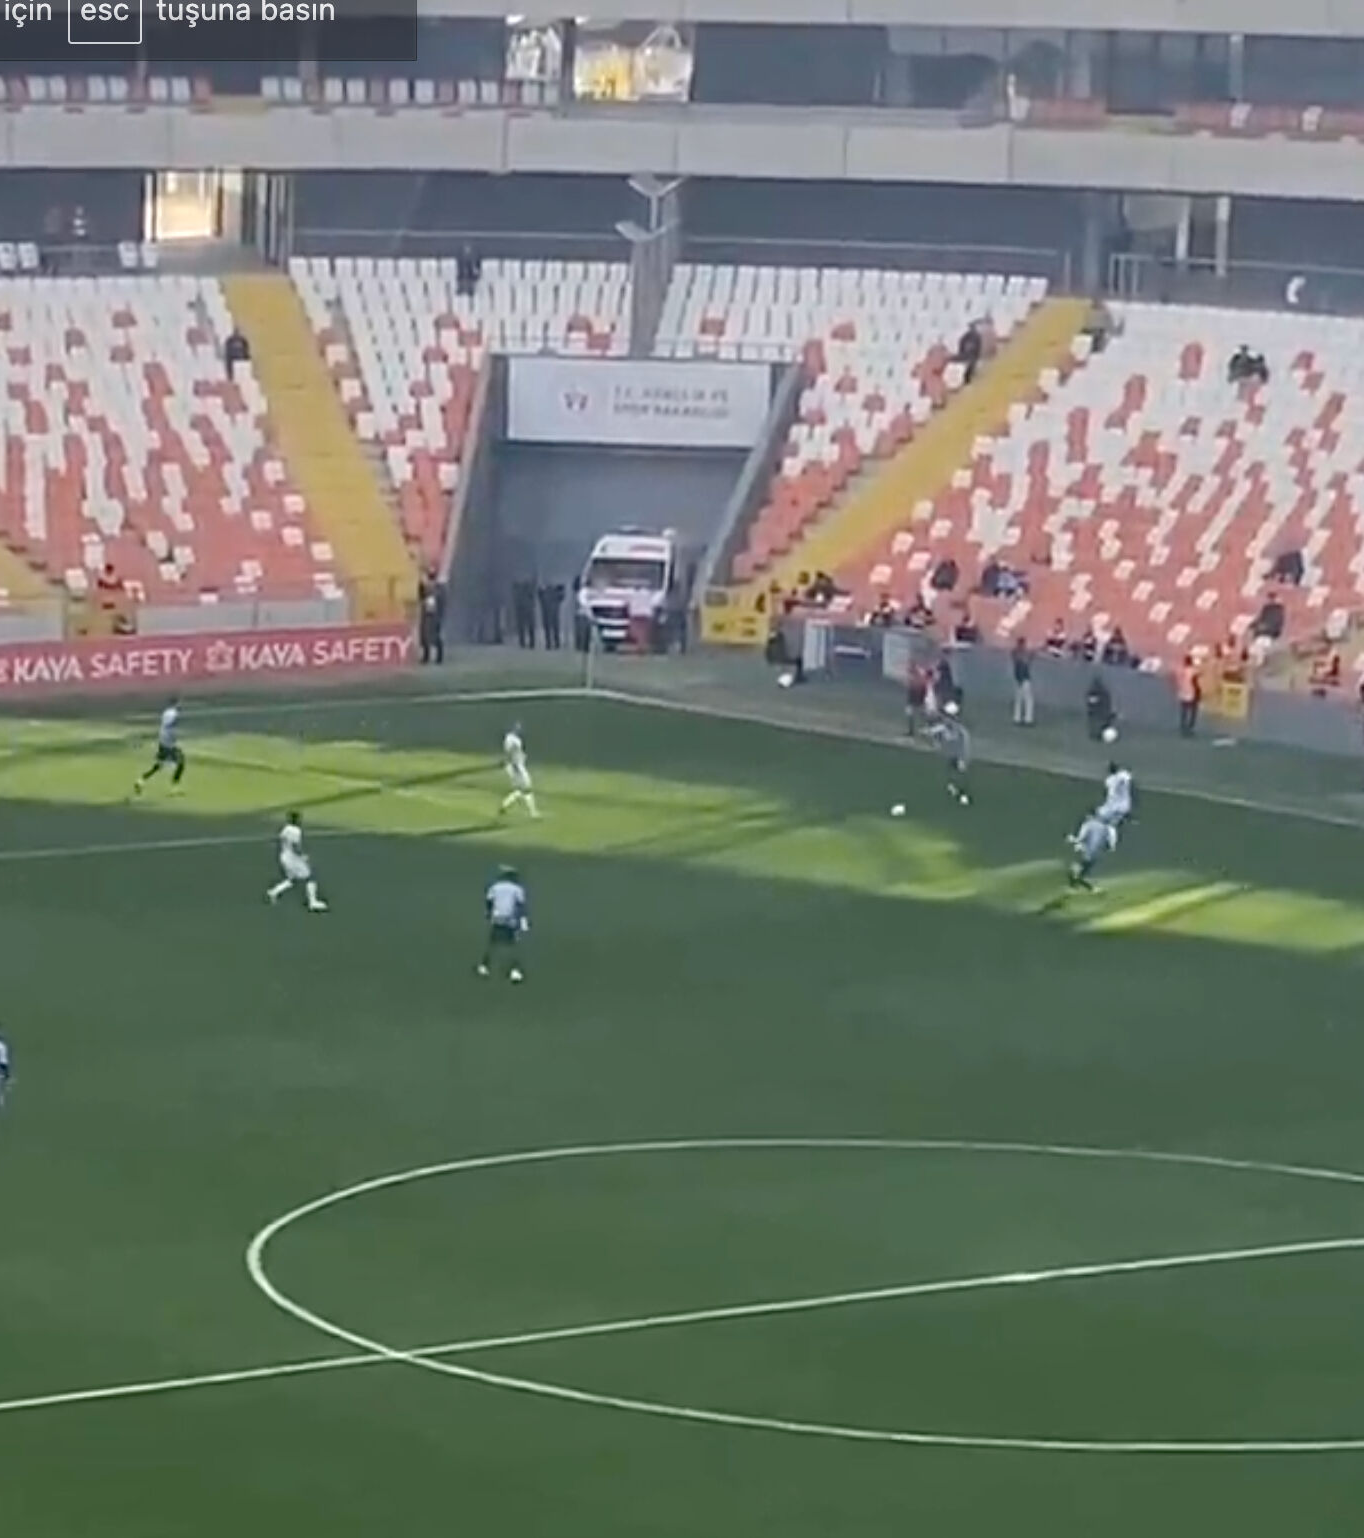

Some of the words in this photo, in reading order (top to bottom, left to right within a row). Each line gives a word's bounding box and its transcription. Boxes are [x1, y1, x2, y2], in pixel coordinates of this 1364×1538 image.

[13, 655, 84, 683] KAYA
[90, 647, 194, 679] SAFETY
[239, 640, 307, 670] KAYA
[312, 634, 414, 666] SAFETY
